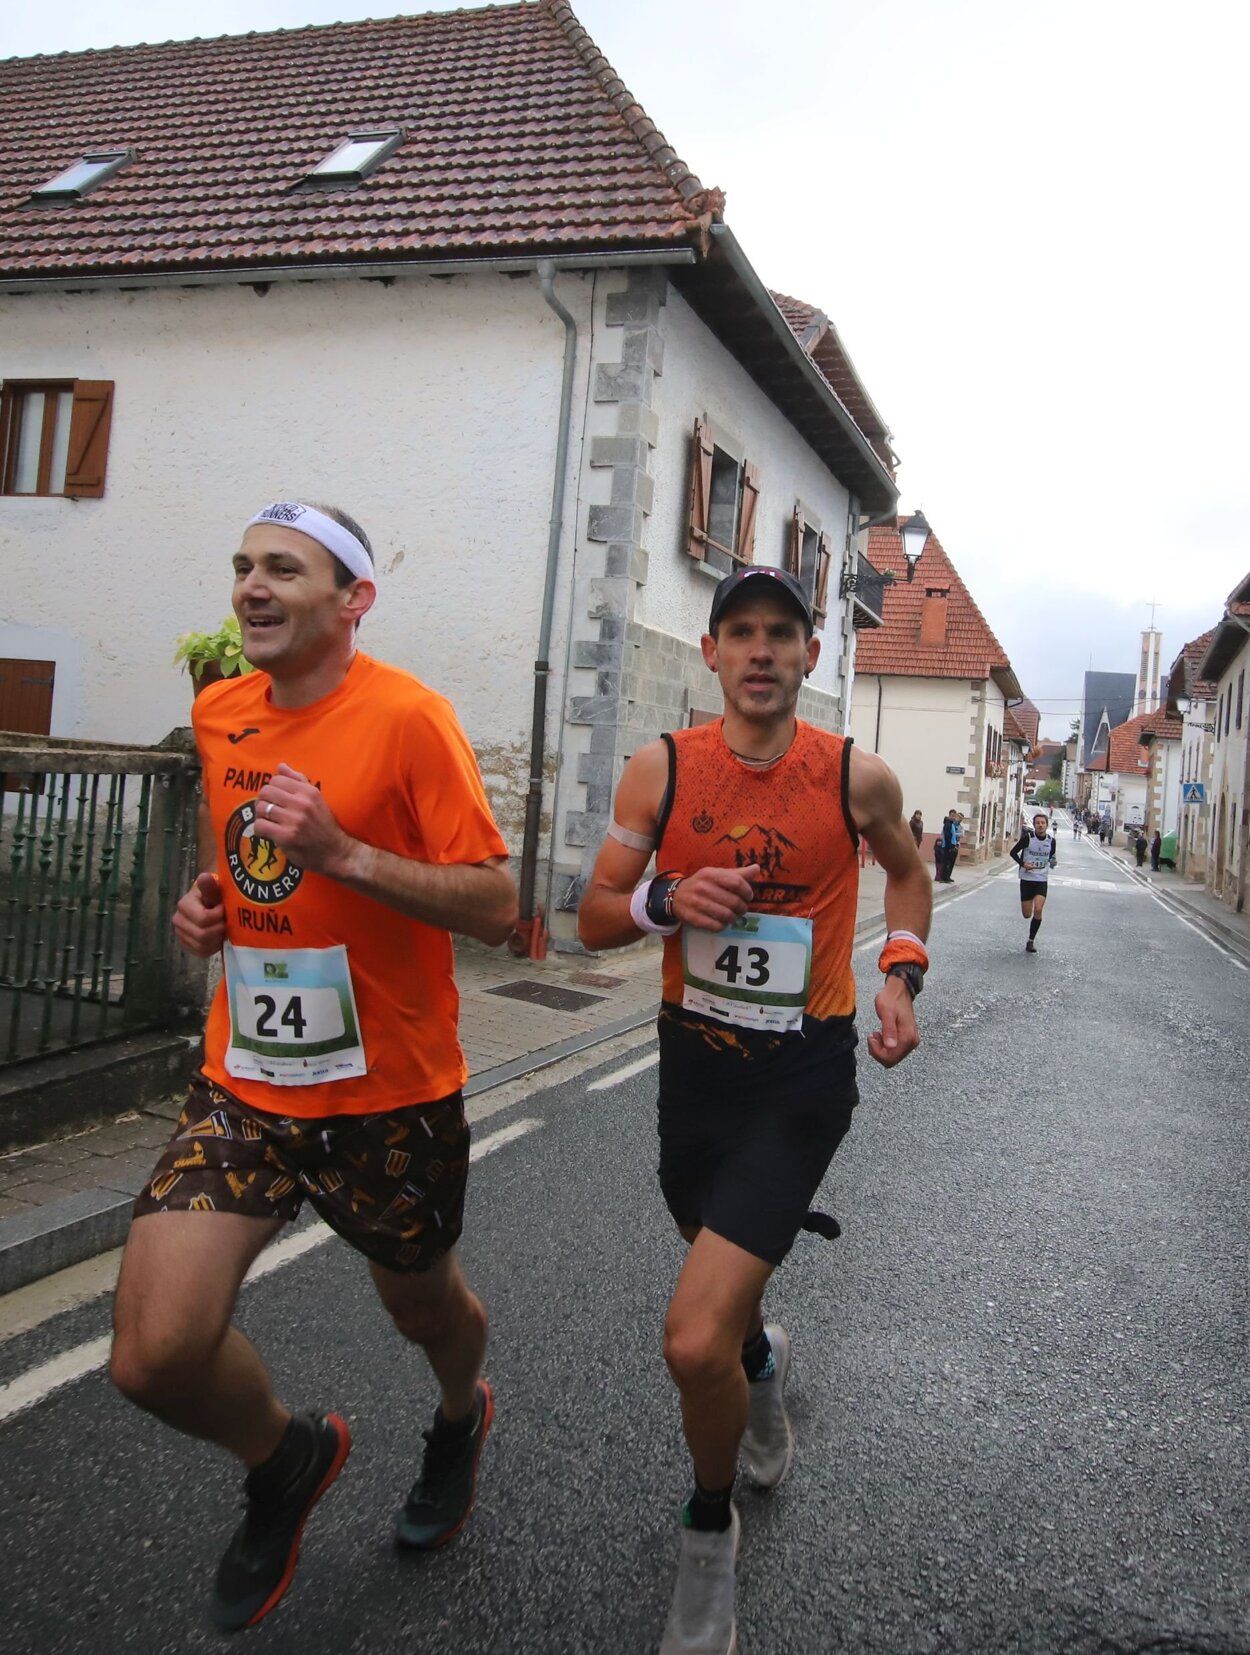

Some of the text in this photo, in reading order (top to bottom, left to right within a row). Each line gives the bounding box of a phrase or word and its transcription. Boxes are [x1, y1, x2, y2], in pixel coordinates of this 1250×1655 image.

[223, 767, 321, 792] PAMPA
[228, 854, 300, 899] RUNNERS
[237, 906, 293, 936] IRUÑA
[715, 945, 770, 987] 43
[254, 994, 307, 1038] 24
